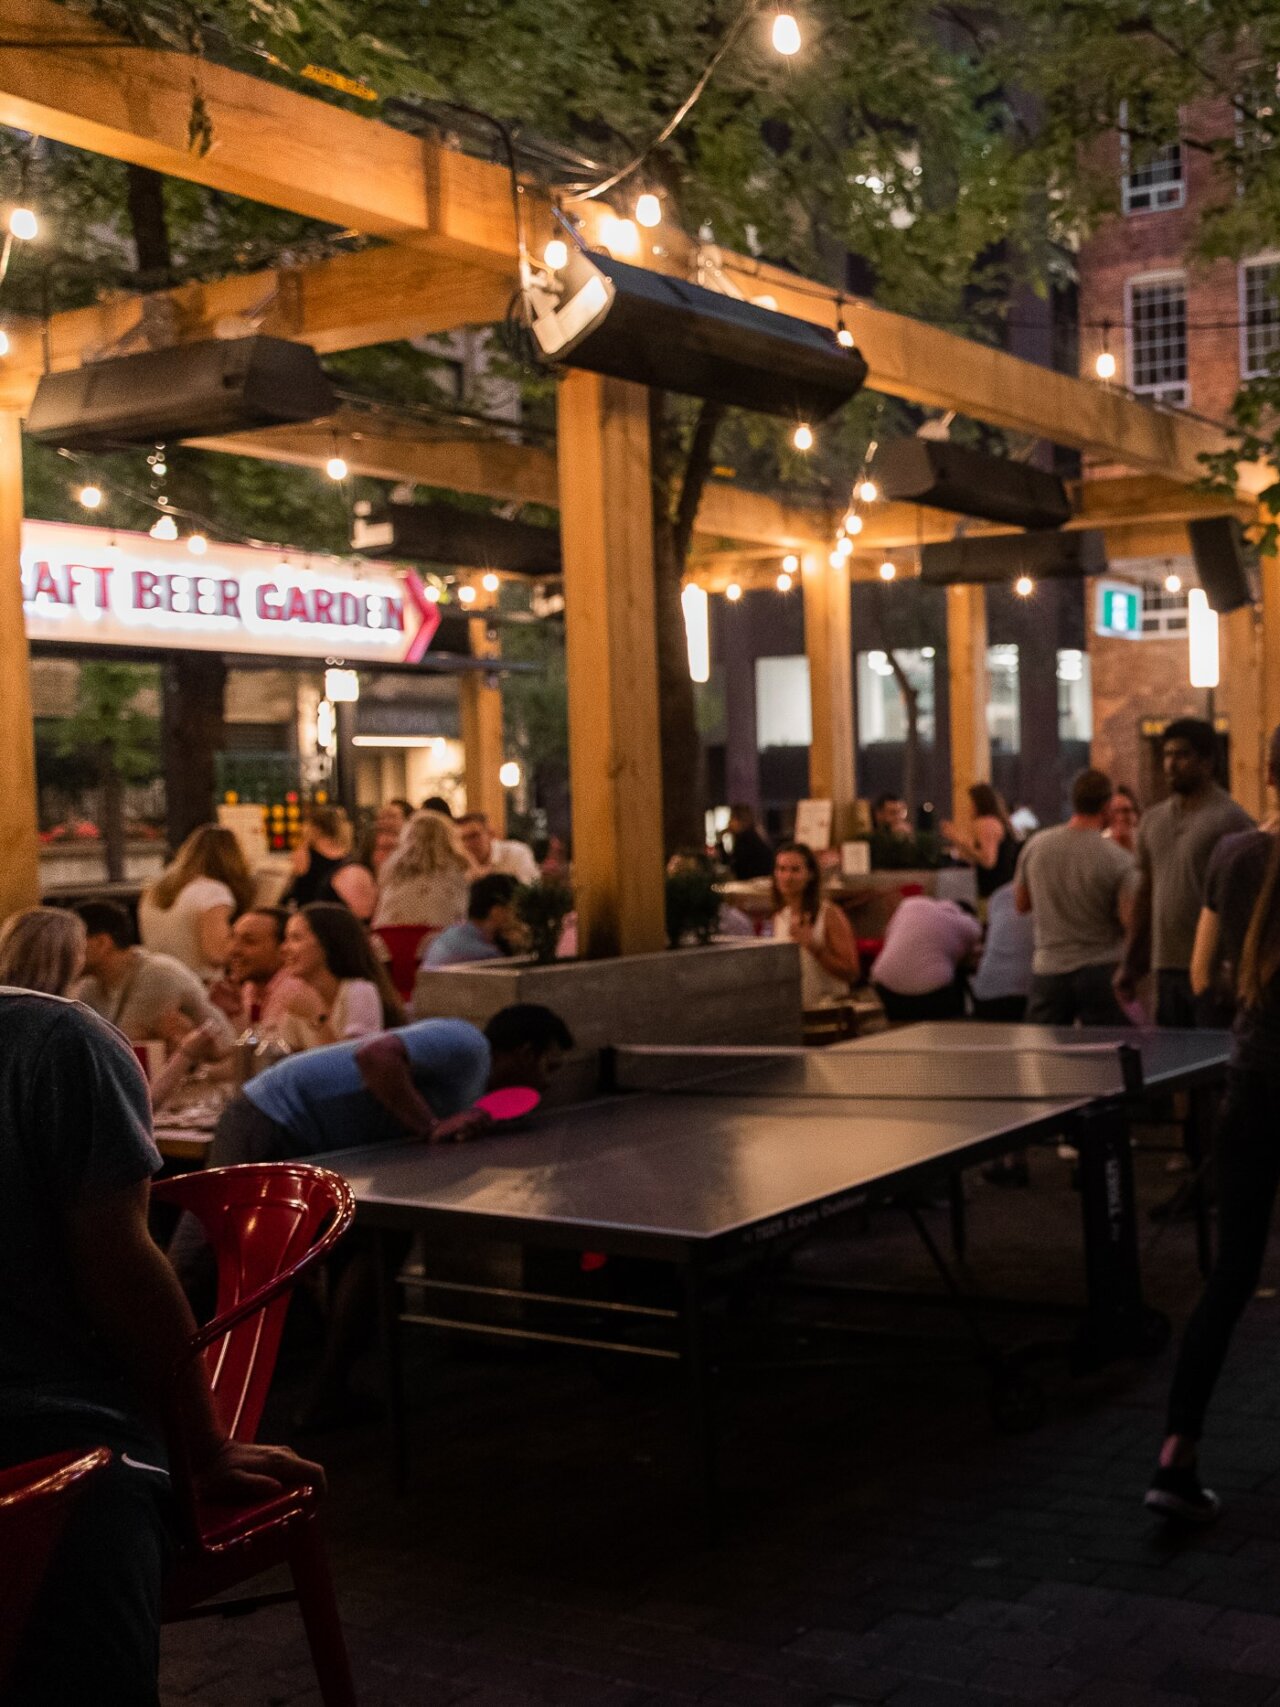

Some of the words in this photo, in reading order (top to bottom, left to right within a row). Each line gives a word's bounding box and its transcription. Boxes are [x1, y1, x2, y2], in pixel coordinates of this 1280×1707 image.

[24, 561, 113, 609] AFT
[132, 571, 240, 618] BEER
[256, 583, 404, 631] GARDEN
